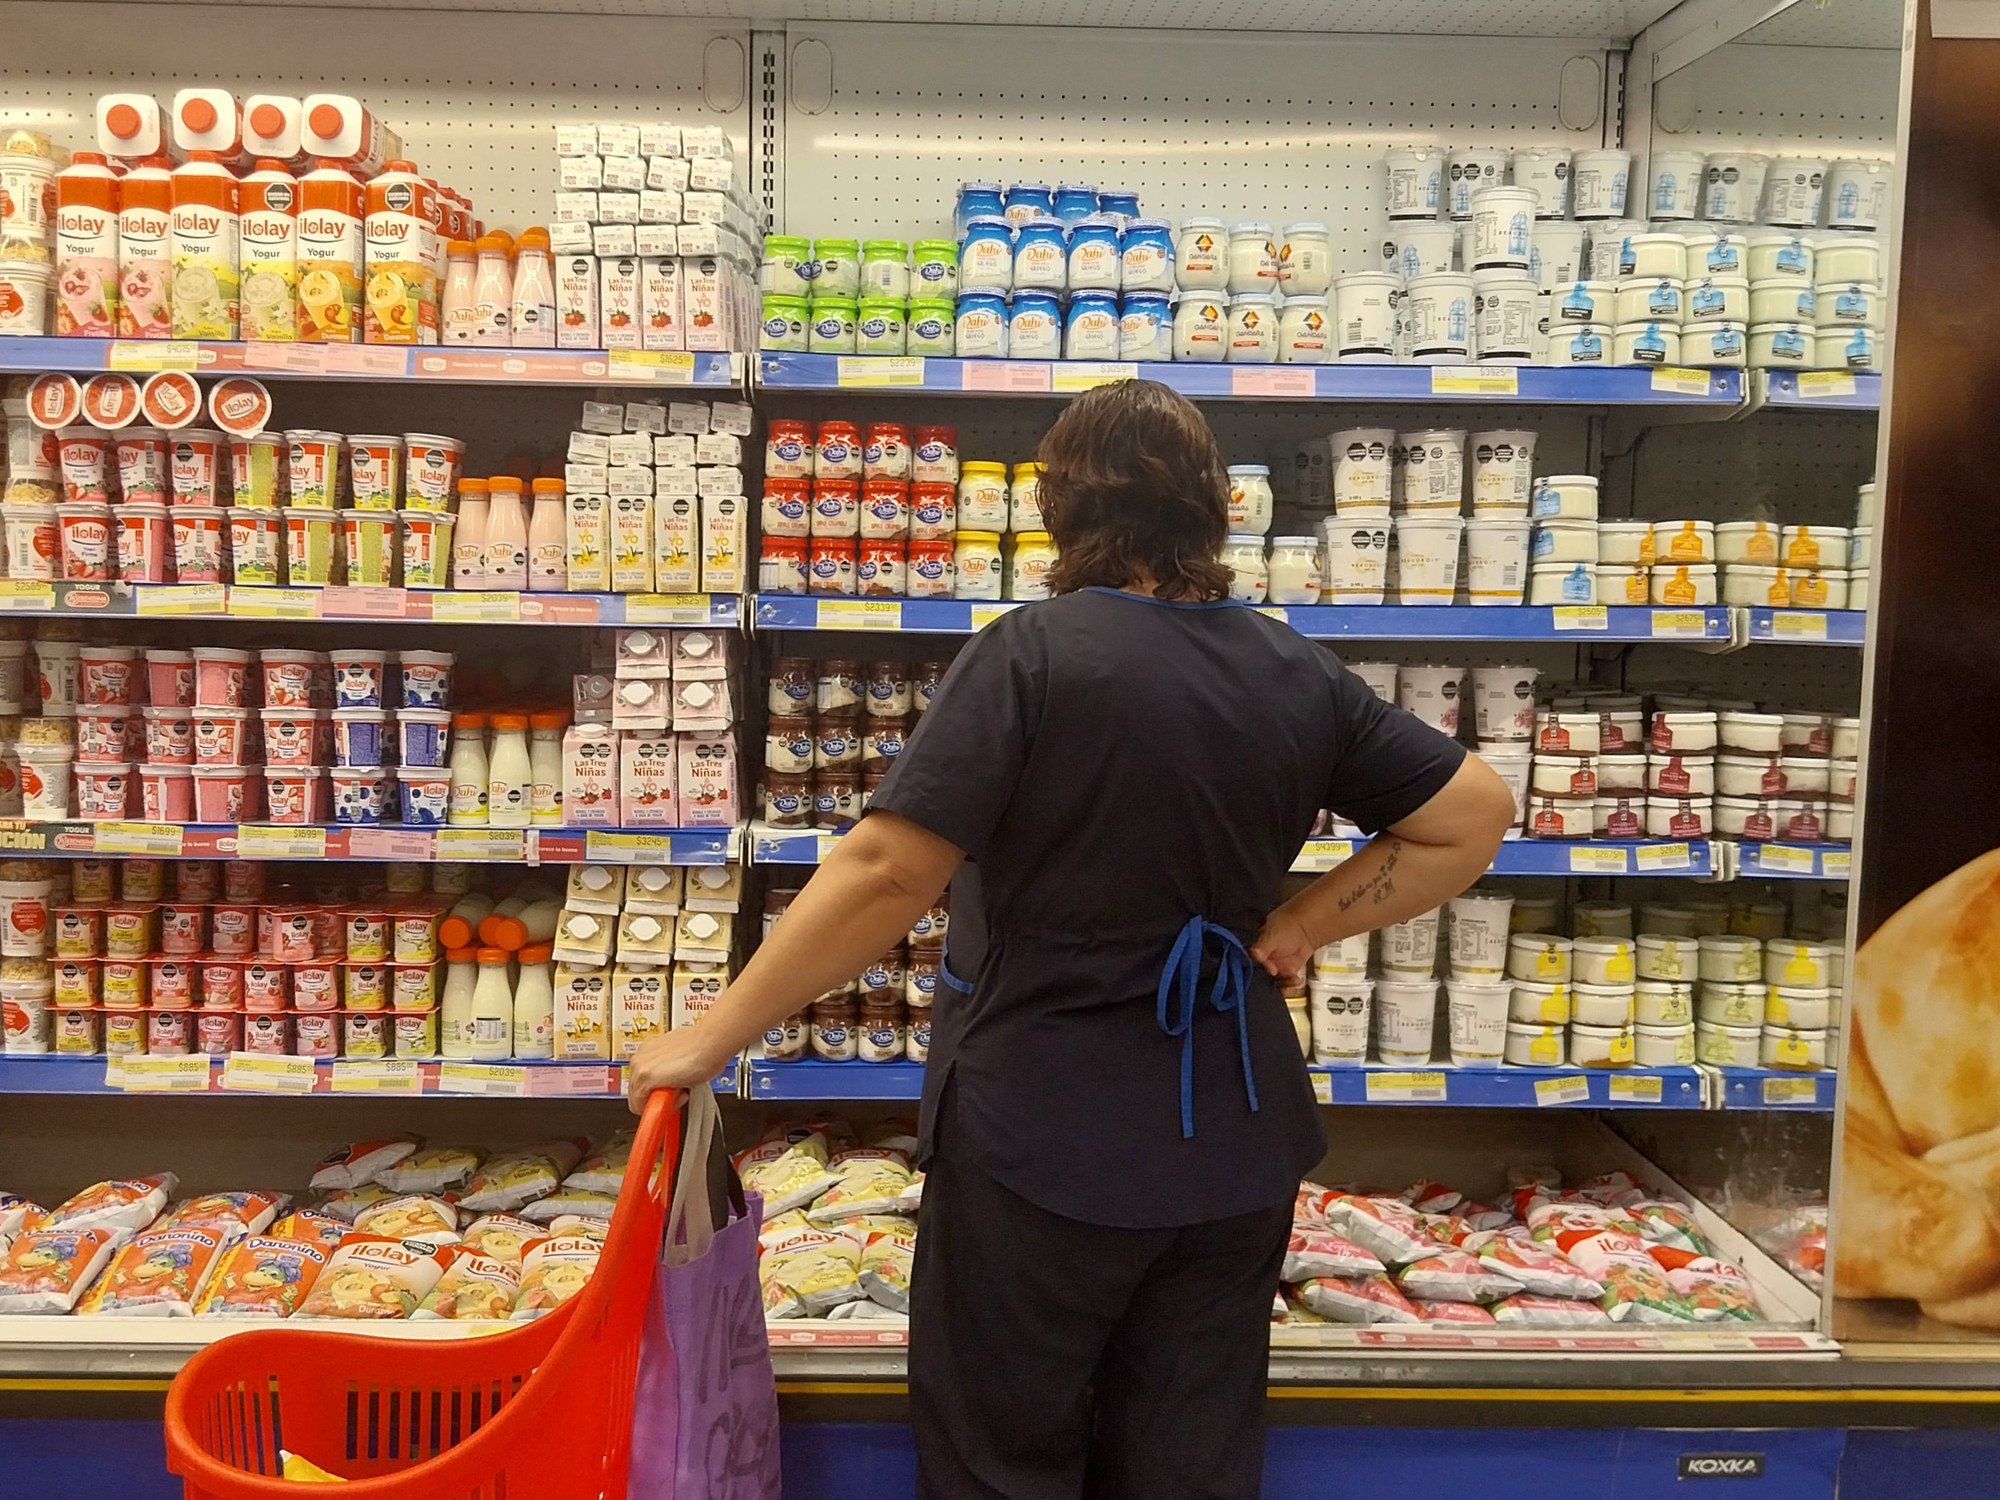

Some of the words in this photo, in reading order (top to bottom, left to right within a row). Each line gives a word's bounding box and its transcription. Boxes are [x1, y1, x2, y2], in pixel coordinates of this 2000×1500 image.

[58, 213, 105, 235] ilolay
[121, 216, 167, 238] ilolay
[174, 213, 220, 234] ilolay
[243, 218, 291, 239] ilolay
[299, 218, 345, 238] ilolay
[367, 218, 410, 239] ilolay
[66, 244, 95, 255] Yogur
[129, 247, 157, 257] Yogur
[182, 244, 210, 254] Yogur
[252, 249, 280, 259] Yogur
[307, 248, 335, 257] Yogur
[976, 243, 1001, 255] Dahi
[1026, 246, 1053, 261] Dahi
[1080, 246, 1104, 260] Dahi
[374, 250, 400, 259] Yogur
[1125, 251, 1151, 263] Dahi
[609, 283, 633, 292] Niñas
[650, 284, 674, 293] Niñas
[691, 284, 715, 292] Niñas
[964, 315, 989, 328] Dahi
[1016, 315, 1042, 329] Dahi
[1080, 316, 1107, 328] Dahi
[660, 354, 684, 364] $1625
[890, 358, 916, 367] $2239
[1100, 364, 1126, 374] $3059
[1480, 367, 1506, 376] $3925
[48, 385, 60, 415] ilolay
[106, 384, 121, 414] ilolay
[159, 384, 184, 411] ilolay
[225, 395, 255, 414] ilolay
[64, 449, 99, 464] ilolay
[420, 468, 447, 483] ilolay
[976, 489, 999, 503] Dahi
[574, 520, 598, 529] Niñas
[618, 520, 642, 529] Niñas
[664, 522, 688, 531] Niñas
[710, 521, 734, 530] Niñas
[71, 525, 107, 541] ilolay
[579, 534, 594, 544] YO
[623, 534, 638, 544] YO
[669, 536, 684, 547] YO
[714, 536, 729, 547] YO
[456, 546, 479, 559] Dahi
[490, 547, 512, 559] Dahi
[538, 547, 561, 559] Dahi
[963, 559, 986, 572] Dahi
[481, 594, 508, 602] $2039
[865, 603, 891, 612] $2339
[1676, 614, 1698, 622] $2675
[102, 665, 128, 675] ilolay
[281, 666, 306, 676] ilolay
[412, 669, 437, 679] ilolay
[345, 679, 368, 689] ilolay
[278, 738, 300, 747] ilolay
[574, 760, 591, 768] Las
[592, 759, 607, 768] Tres
[633, 760, 649, 768] Las
[650, 759, 666, 768] Tres
[691, 761, 707, 769] Las
[707, 760, 723, 769] Tres
[575, 767, 607, 777] Niñas
[634, 767, 665, 776] Niñas
[692, 768, 722, 778] Niñas
[424, 787, 446, 795] ilolay
[583, 781, 599, 792] YO
[641, 781, 657, 792] YO
[699, 783, 715, 792] YO
[103, 793, 125, 801] ilolay
[489, 832, 515, 840] $2039
[636, 836, 662, 846] $3245
[1316, 842, 1340, 851] $4399
[1660, 846, 1682, 855] $2675
[1596, 850, 1618, 858] $2675
[114, 916, 137, 927] ilolay
[220, 914, 243, 923] ilolay
[405, 922, 428, 932] ilolay
[109, 966, 133, 977] ilolay
[210, 970, 232, 979] ilolay
[302, 971, 326, 981] ilolay
[403, 971, 426, 981] ilolay
[581, 993, 598, 1001] Tres
[567, 1002, 598, 1011] Niñas
[624, 1002, 655, 1011] Niñas
[111, 1018, 134, 1028] ilolay
[204, 1019, 228, 1028] ilolay
[302, 1020, 324, 1028] ilolay
[400, 1019, 422, 1028] ilolay
[179, 1062, 200, 1072] $885
[286, 1063, 308, 1073] $885
[386, 1062, 407, 1071] $885
[489, 1066, 515, 1076] $2039
[514, 1168, 540, 1180] Vainilla
[873, 1183, 904, 1192] Vainilla
[402, 1223, 439, 1234] Durazno
[487, 1214, 548, 1233] ilolay
[138, 1231, 215, 1248] Danonino
[775, 1233, 838, 1253] ilolay
[246, 1237, 324, 1263] Danonino
[543, 1239, 604, 1254] ilolay
[794, 1246, 819, 1255] Yogur
[351, 1245, 421, 1265] ilolay
[364, 1263, 391, 1271] Yogur
[815, 1273, 847, 1284] Vainilla
[1688, 1459, 1756, 1474] KOXKA
